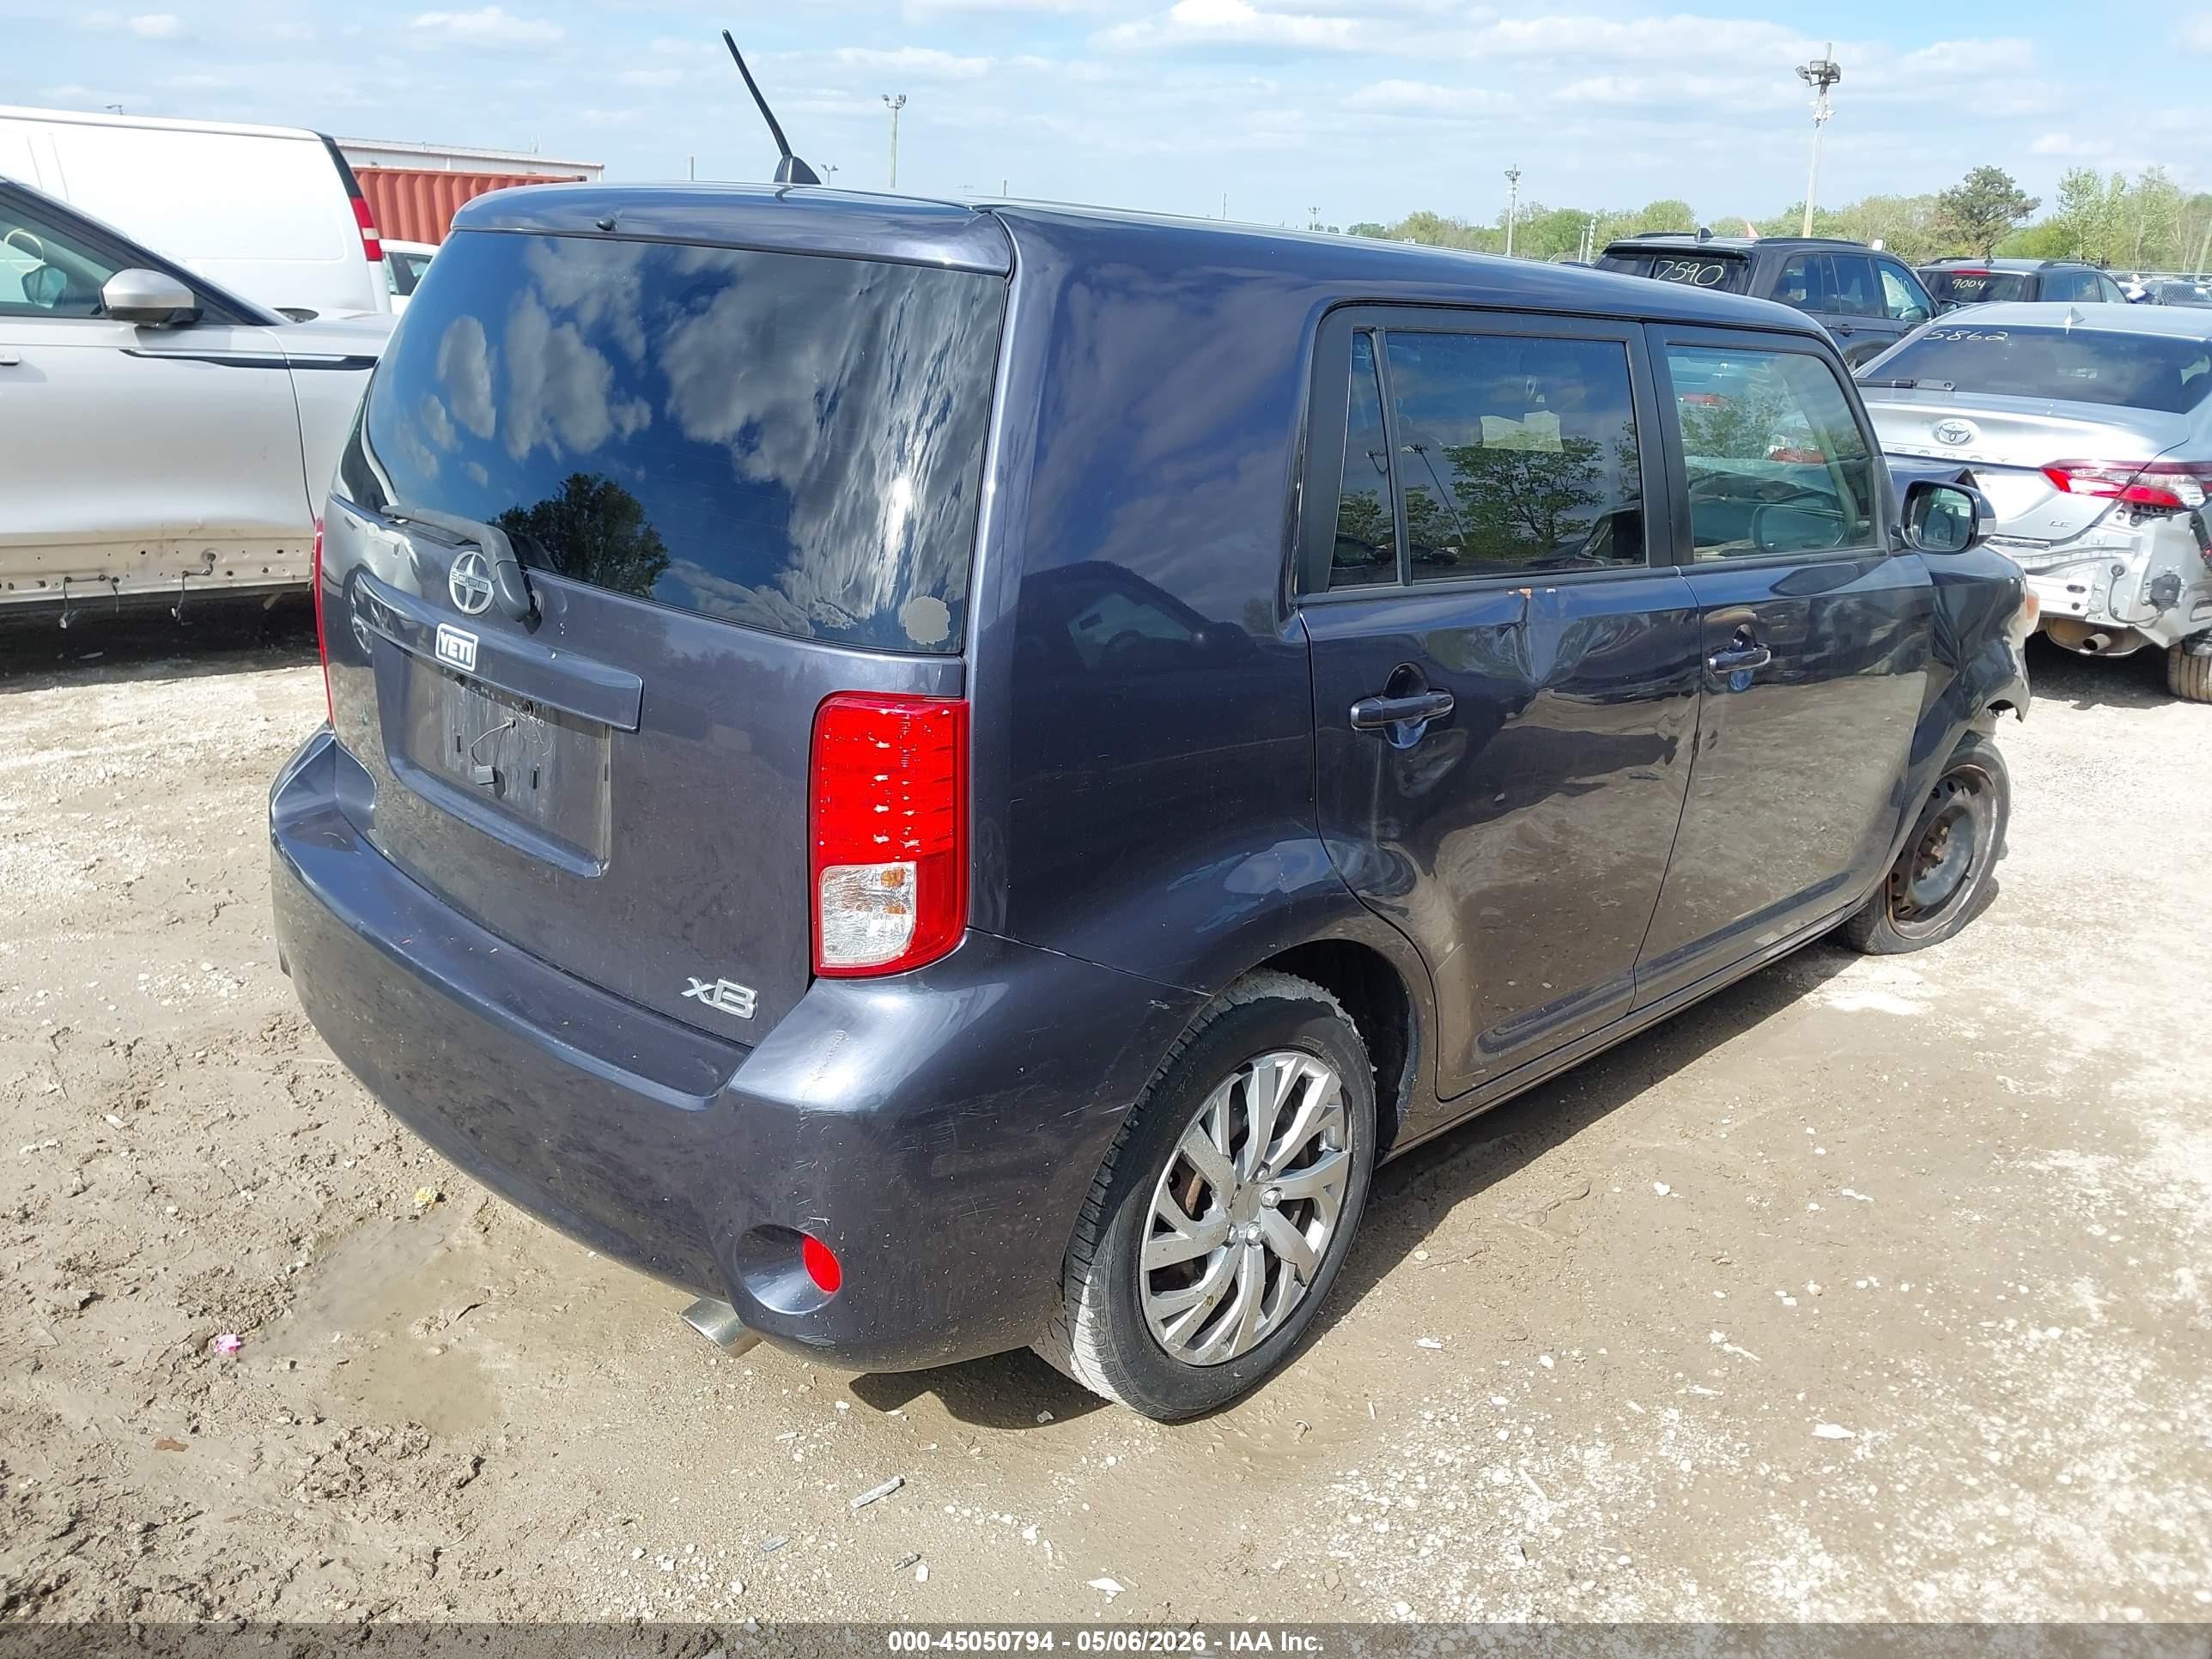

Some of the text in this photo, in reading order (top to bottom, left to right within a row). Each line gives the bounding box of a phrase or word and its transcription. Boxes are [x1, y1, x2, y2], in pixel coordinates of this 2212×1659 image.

[1656, 260, 1724, 286] 7590
[1952, 278, 1986, 290] 9004
[1923, 329, 2008, 341] 5862
[439, 630, 474, 664] YETI
